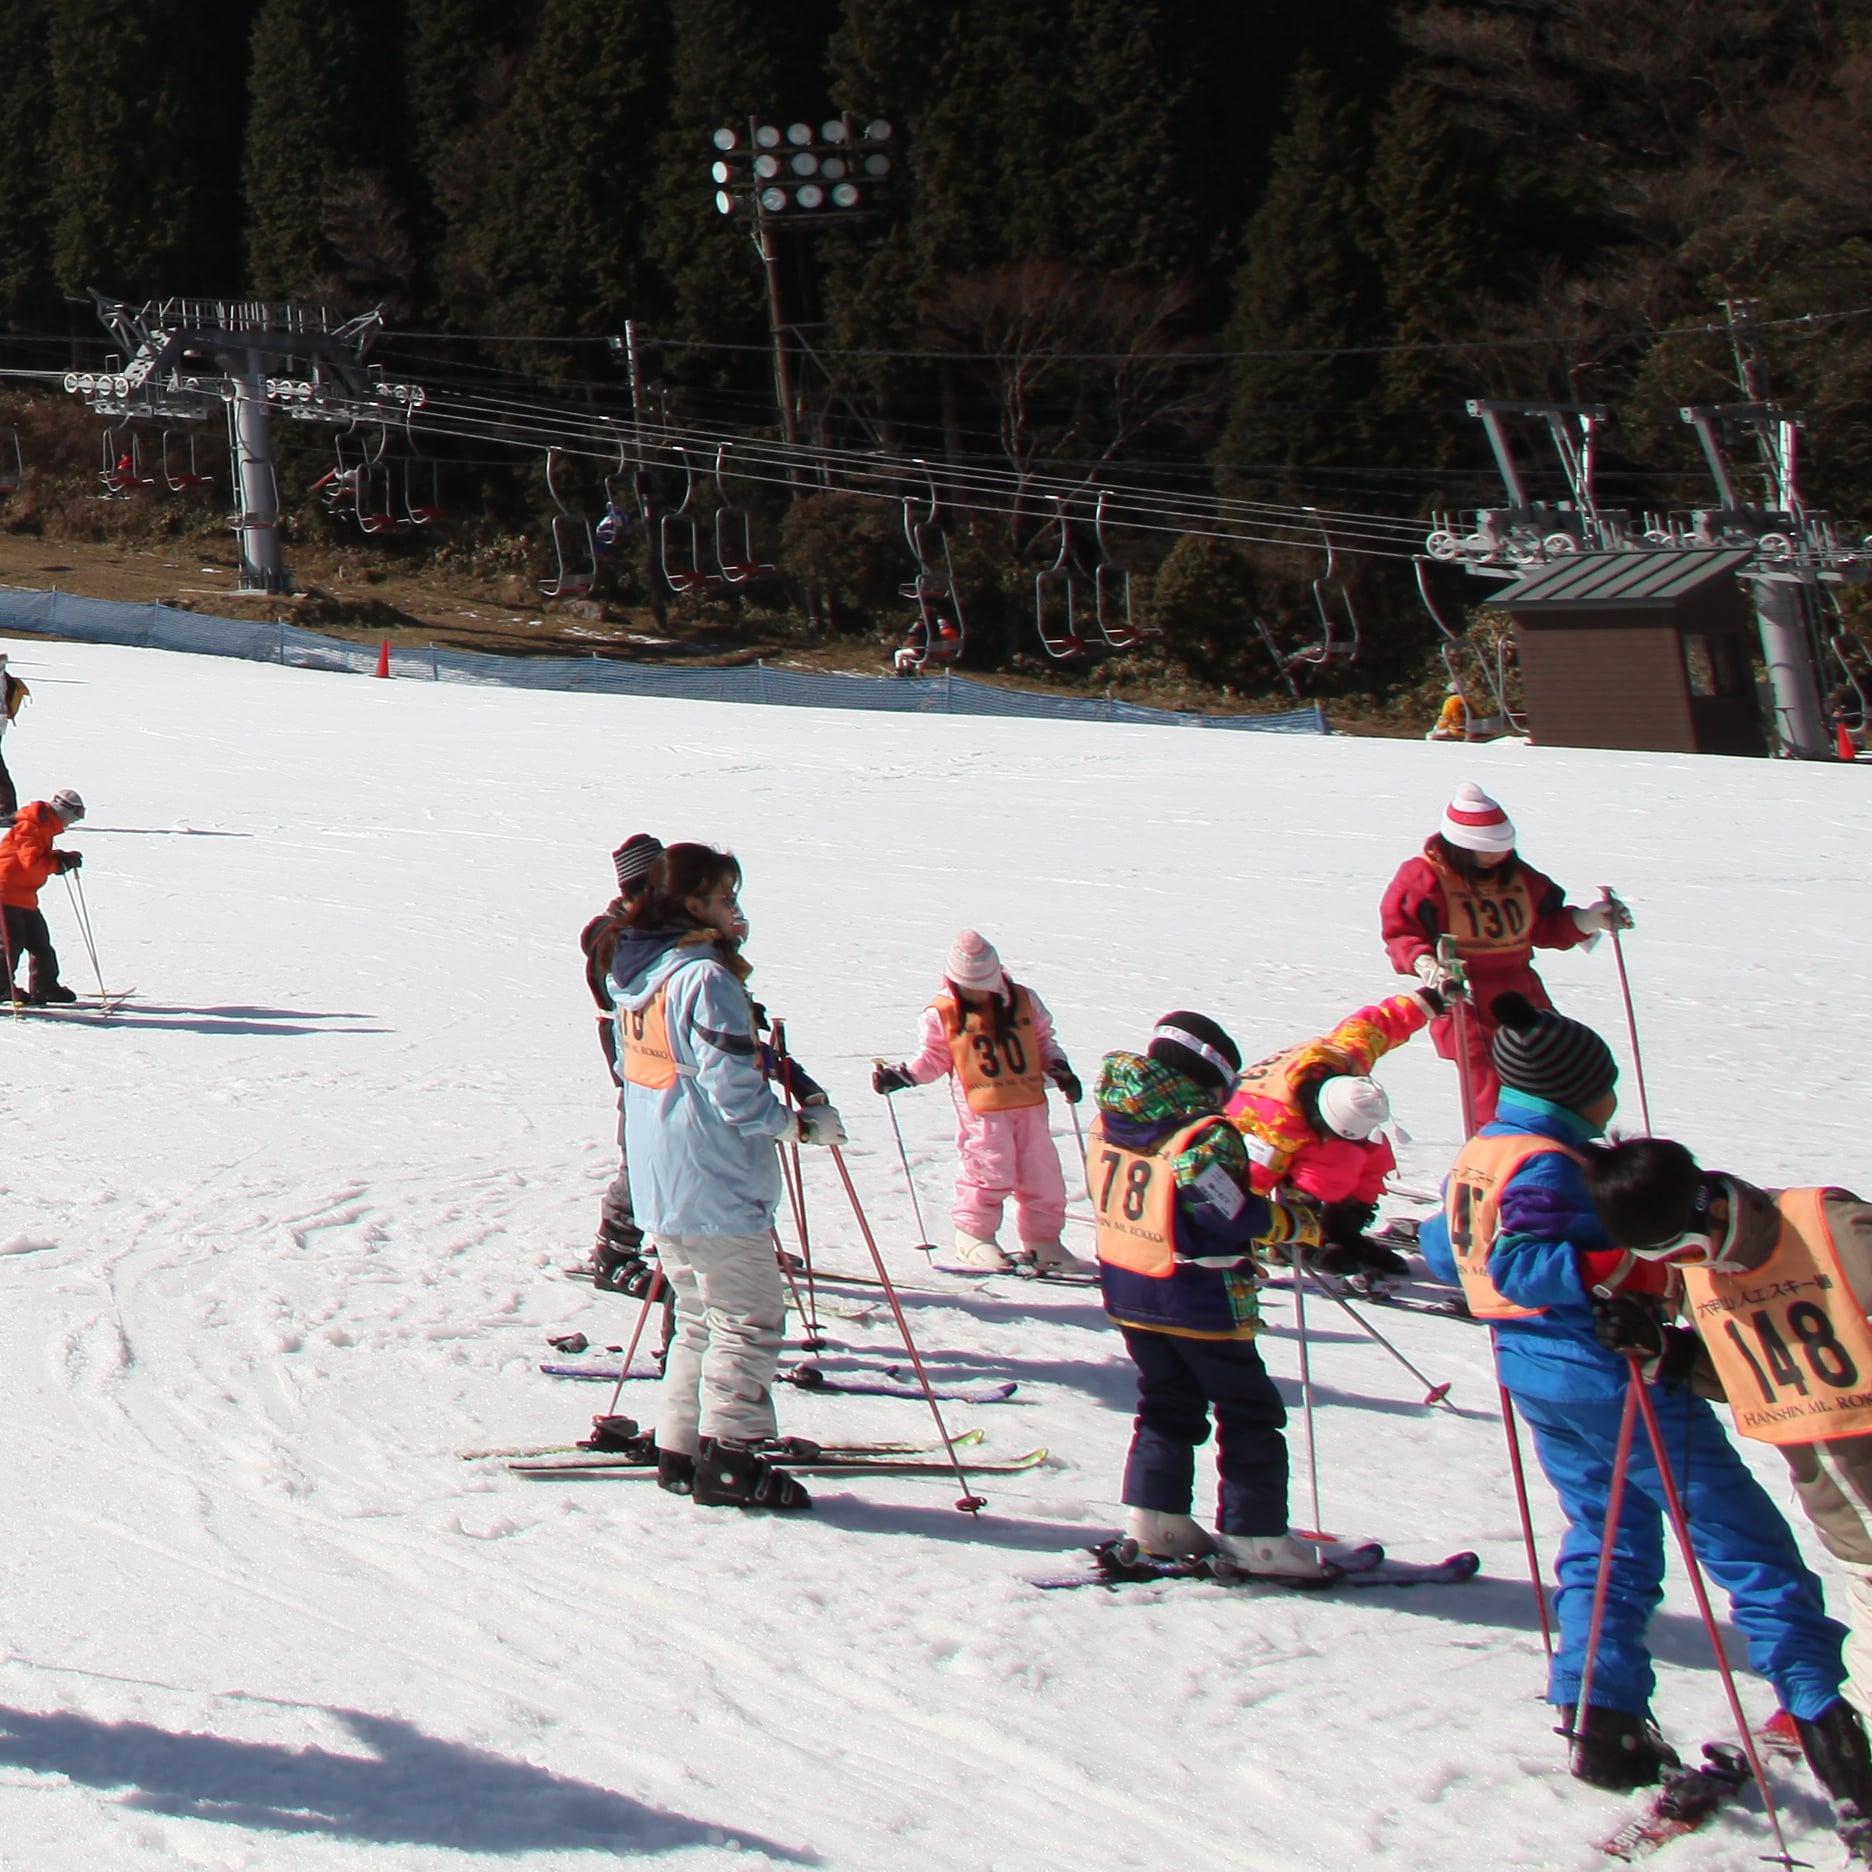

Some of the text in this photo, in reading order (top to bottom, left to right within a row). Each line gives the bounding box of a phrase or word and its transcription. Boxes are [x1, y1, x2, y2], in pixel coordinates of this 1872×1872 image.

[1463, 897, 1525, 939] 130
[972, 1030, 1027, 1078] 30
[1099, 1148, 1153, 1222] 78
[1724, 1301, 1858, 1403] 148
[1743, 1405, 1805, 1427] HANSHIN
